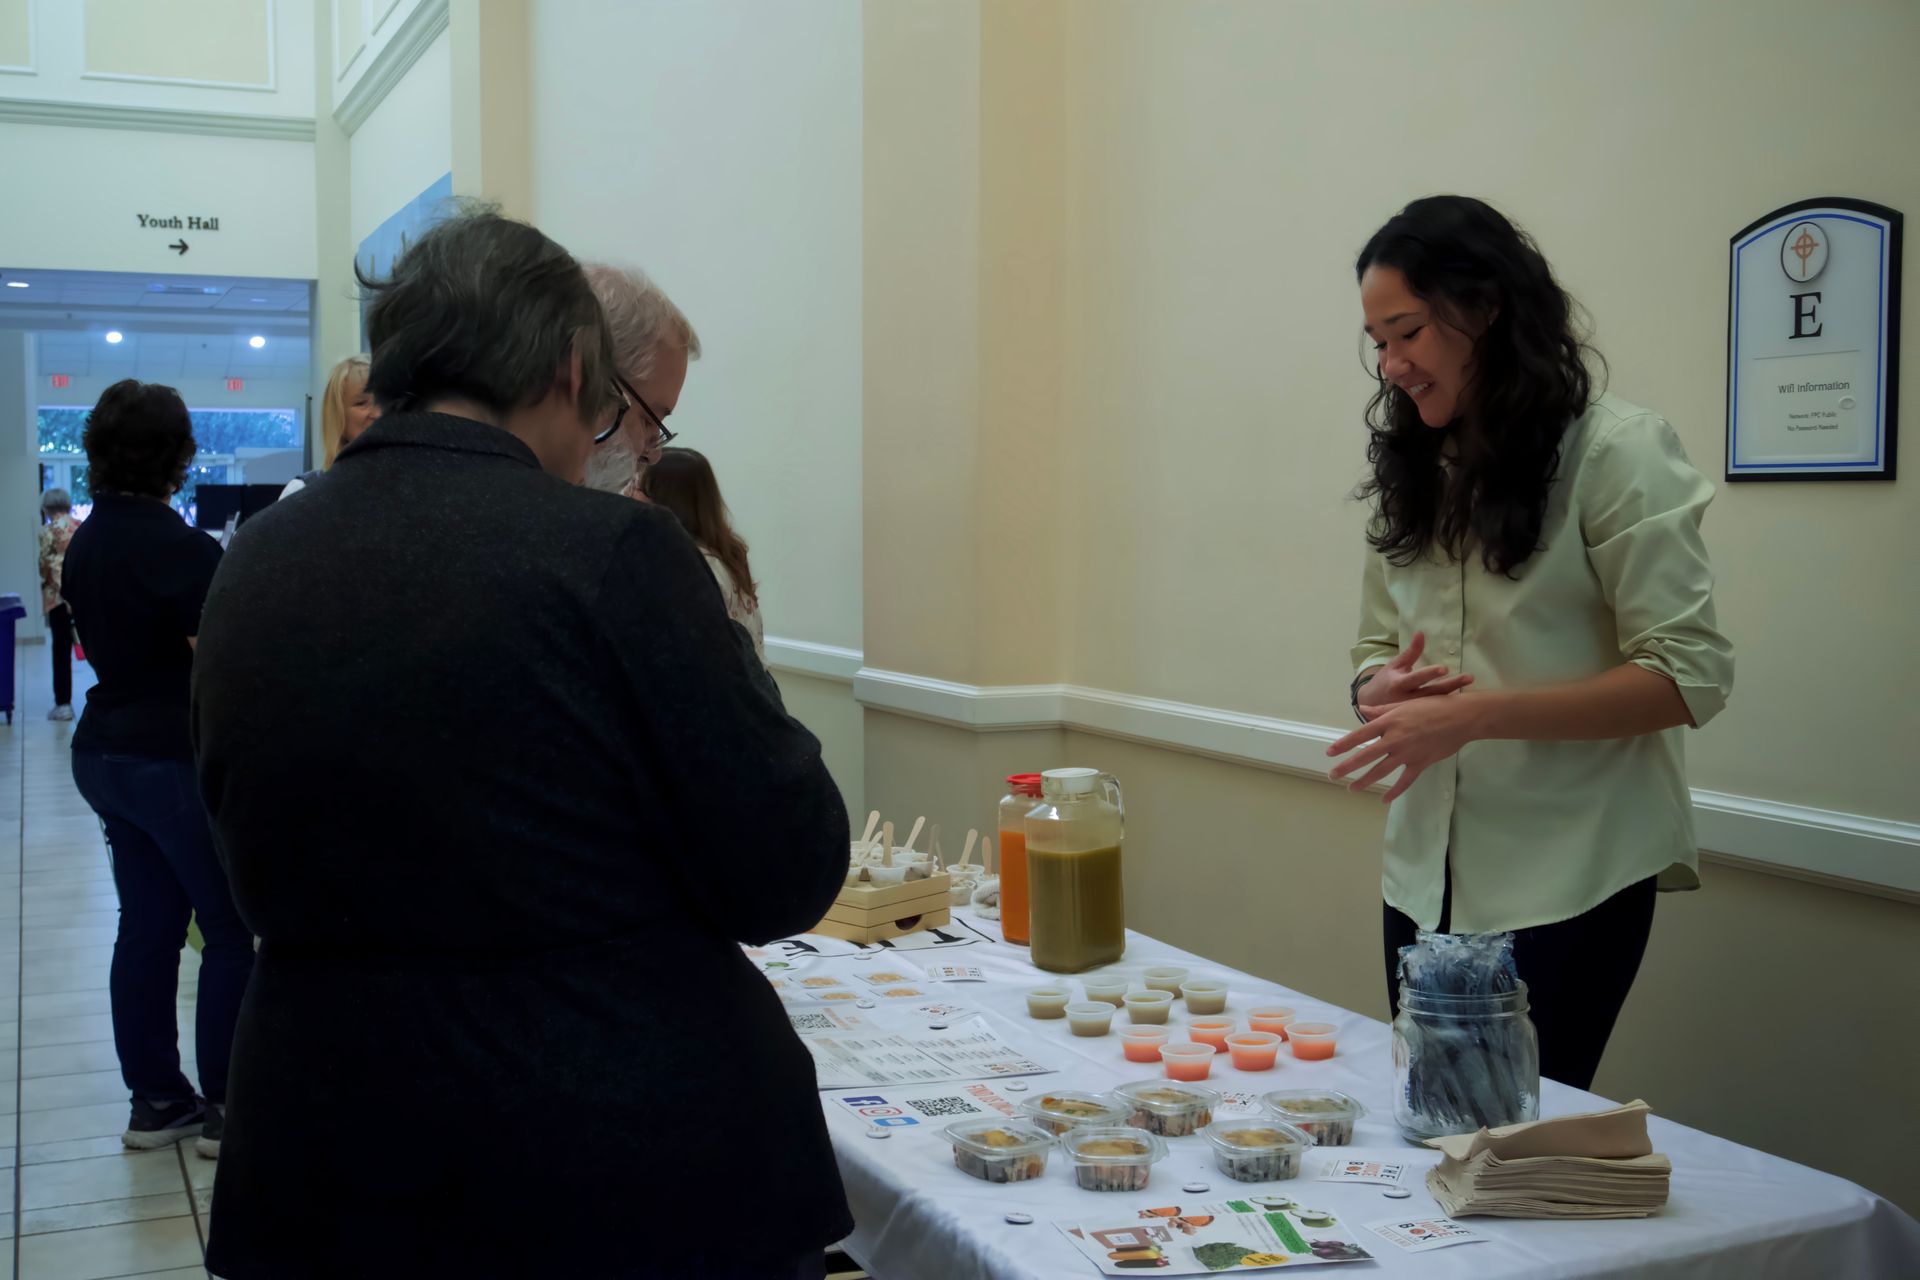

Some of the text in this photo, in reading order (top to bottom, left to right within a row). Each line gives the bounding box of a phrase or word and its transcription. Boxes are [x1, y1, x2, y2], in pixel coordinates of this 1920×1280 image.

[136, 213, 219, 231] Youth Hall
[1788, 291, 1823, 339] E
[1778, 380, 1850, 394] Wifi Information
[1433, 1219, 1471, 1235] THE
